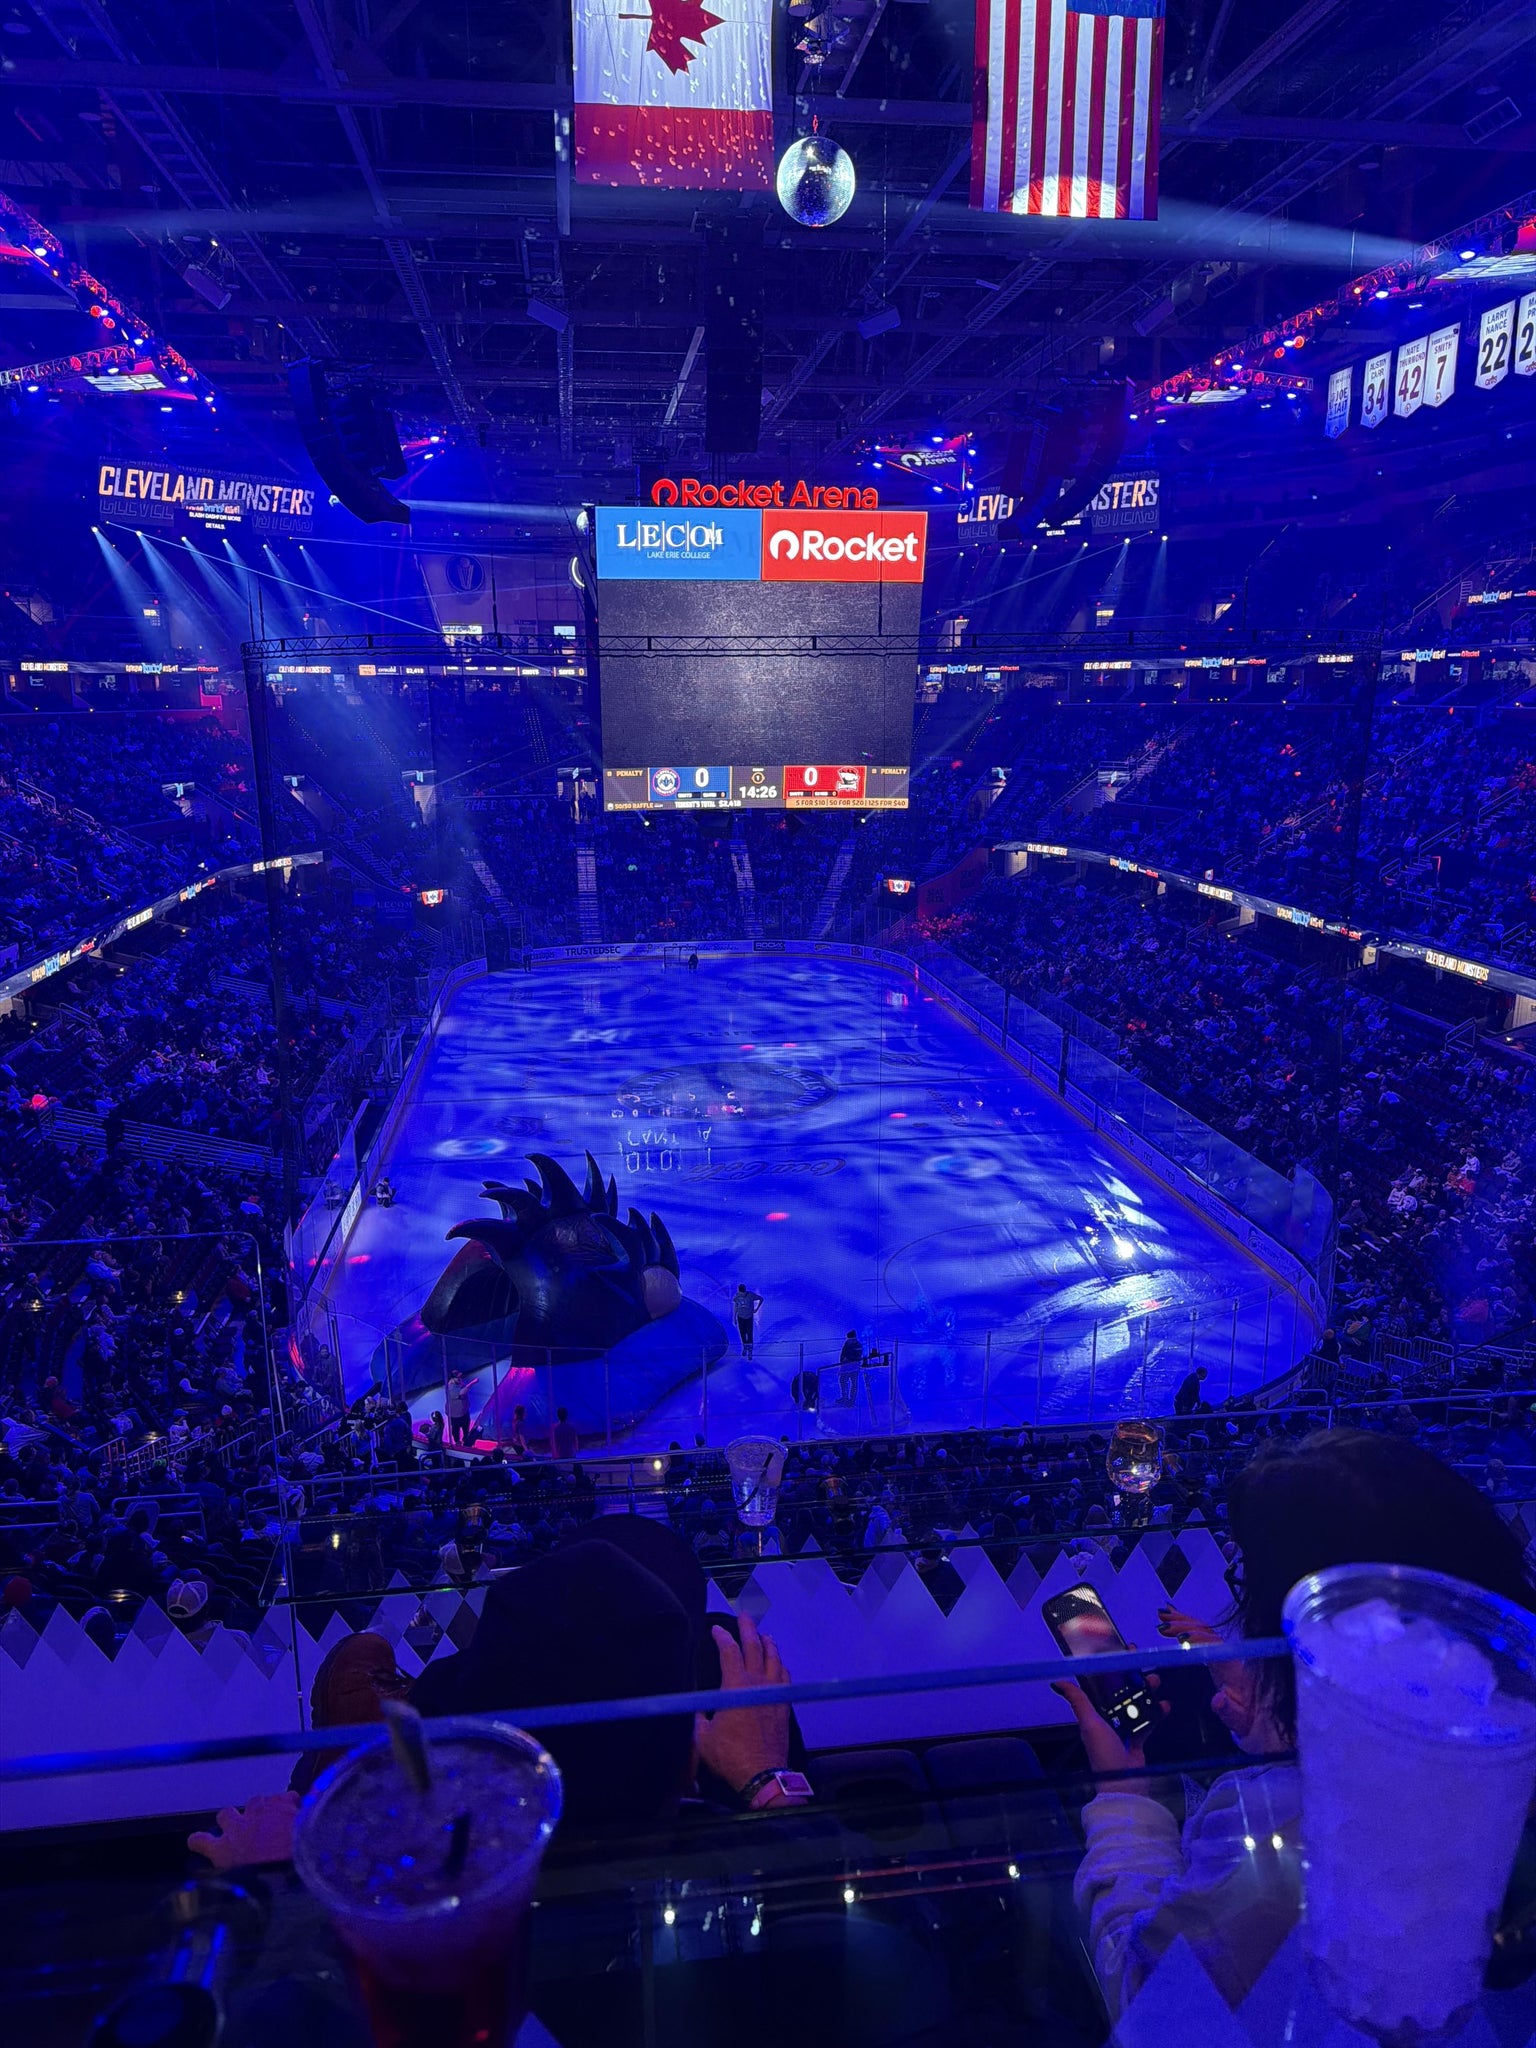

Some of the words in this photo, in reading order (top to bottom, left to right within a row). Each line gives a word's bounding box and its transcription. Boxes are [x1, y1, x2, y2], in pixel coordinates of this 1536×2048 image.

[1487, 307, 1508, 325] LARRY
[1486, 319, 1508, 336] NANCE
[1407, 343, 1420, 355] NATE
[1434, 341, 1453, 355] SMITH
[1481, 332, 1508, 375] 22
[1400, 352, 1426, 368] THURMOND
[1437, 355, 1448, 391] 7
[1398, 365, 1422, 403] 42
[1335, 387, 1348, 402] JOE
[1365, 379, 1385, 415] 34
[1334, 399, 1347, 414] TAIT
[925, 456, 957, 466] Arena
[98, 466, 214, 502] CLEVELAND
[219, 480, 315, 515] MONSTERS
[681, 478, 785, 507] Rocket
[789, 480, 878, 509] Arena
[646, 551, 664, 559] LAKE
[671, 551, 686, 559] ERIE
[688, 551, 711, 560] COLLEGE
[802, 531, 919, 562] Rocket
[695, 767, 709, 787] 0
[804, 767, 818, 786] 0
[739, 785, 777, 799] 14:26
[565, 946, 620, 957] TRUSTEDSEC
[1425, 950, 1457, 972] CLEVELAND
[1456, 959, 1490, 982] MONSTERS
